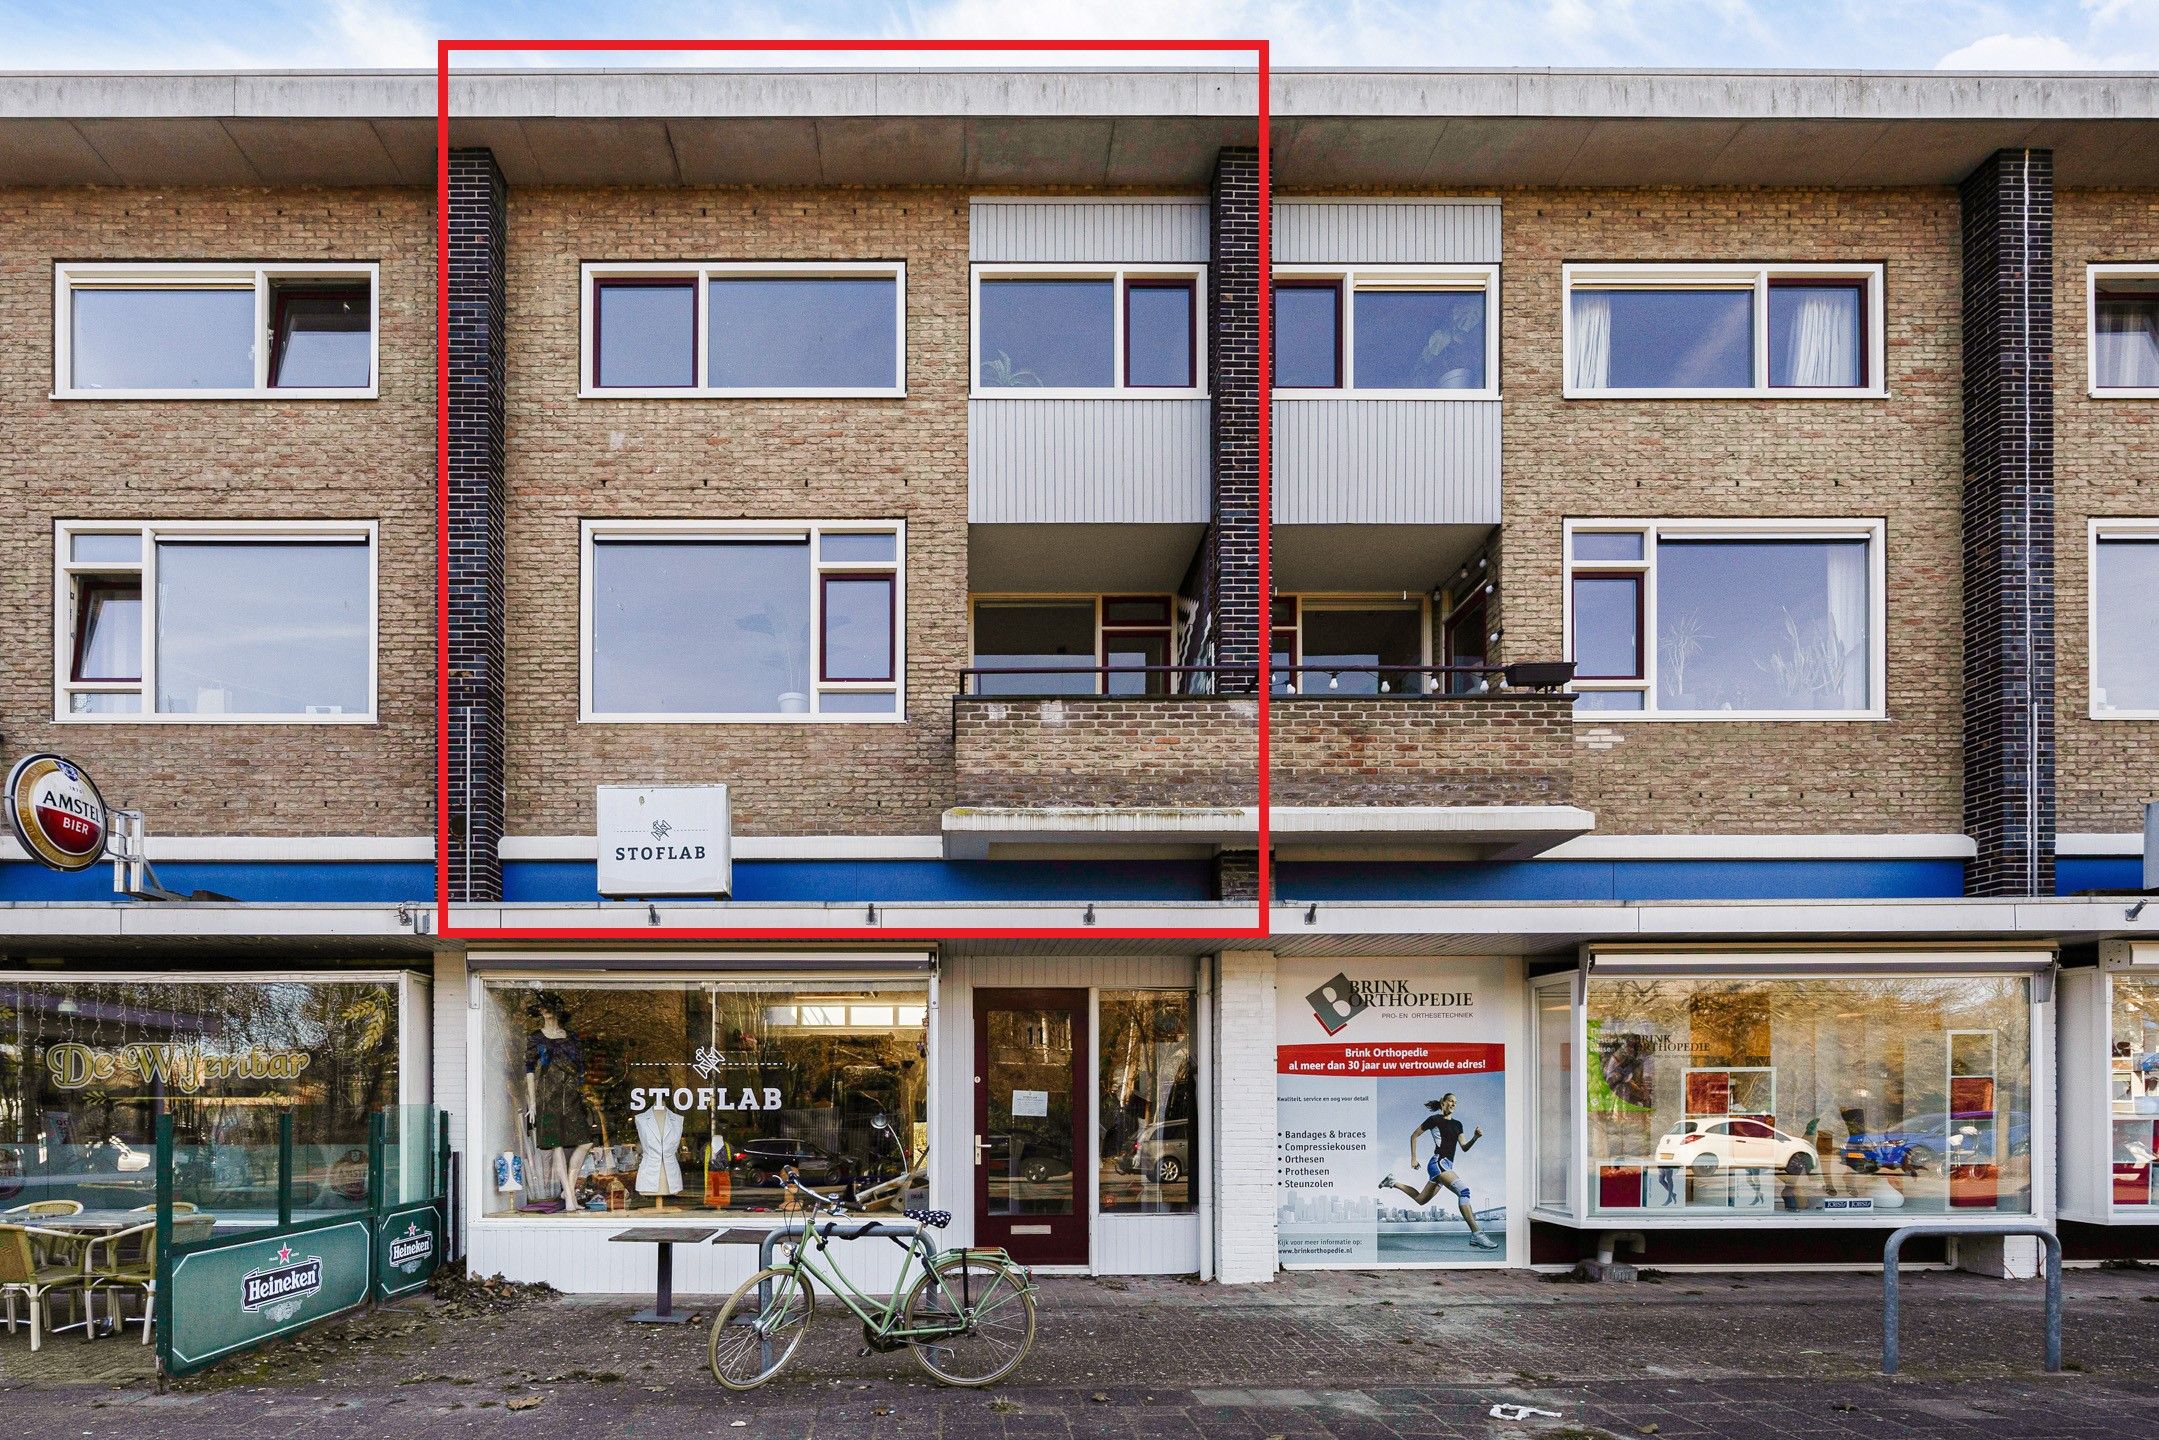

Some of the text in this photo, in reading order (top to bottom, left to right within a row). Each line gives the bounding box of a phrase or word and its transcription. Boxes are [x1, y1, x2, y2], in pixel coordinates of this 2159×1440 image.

[43, 790, 100, 824] AMSTEL
[63, 817, 89, 835] BIER
[615, 846, 706, 861] STOFLAB
[1349, 980, 1410, 994] BRINK
[1349, 993, 1474, 1007] ORTHOPEDIE
[1345, 1048, 1428, 1059] Brink Orthopedie
[46, 1042, 116, 1090] De
[1288, 1059, 1486, 1072] al meer dan 30 jaar uw vertrouwde adres!
[630, 1087, 782, 1111] STOFLAB
[1285, 1130, 1367, 1140] Bandages & braces
[1285, 1142, 1367, 1153] Compressiekousen
[1285, 1155, 1325, 1163] Orthesen
[1285, 1167, 1330, 1176] Prothesen
[1285, 1179, 1334, 1188] Steunzolen
[393, 1240, 430, 1260] Heineken
[248, 1269, 317, 1302] Heineken
